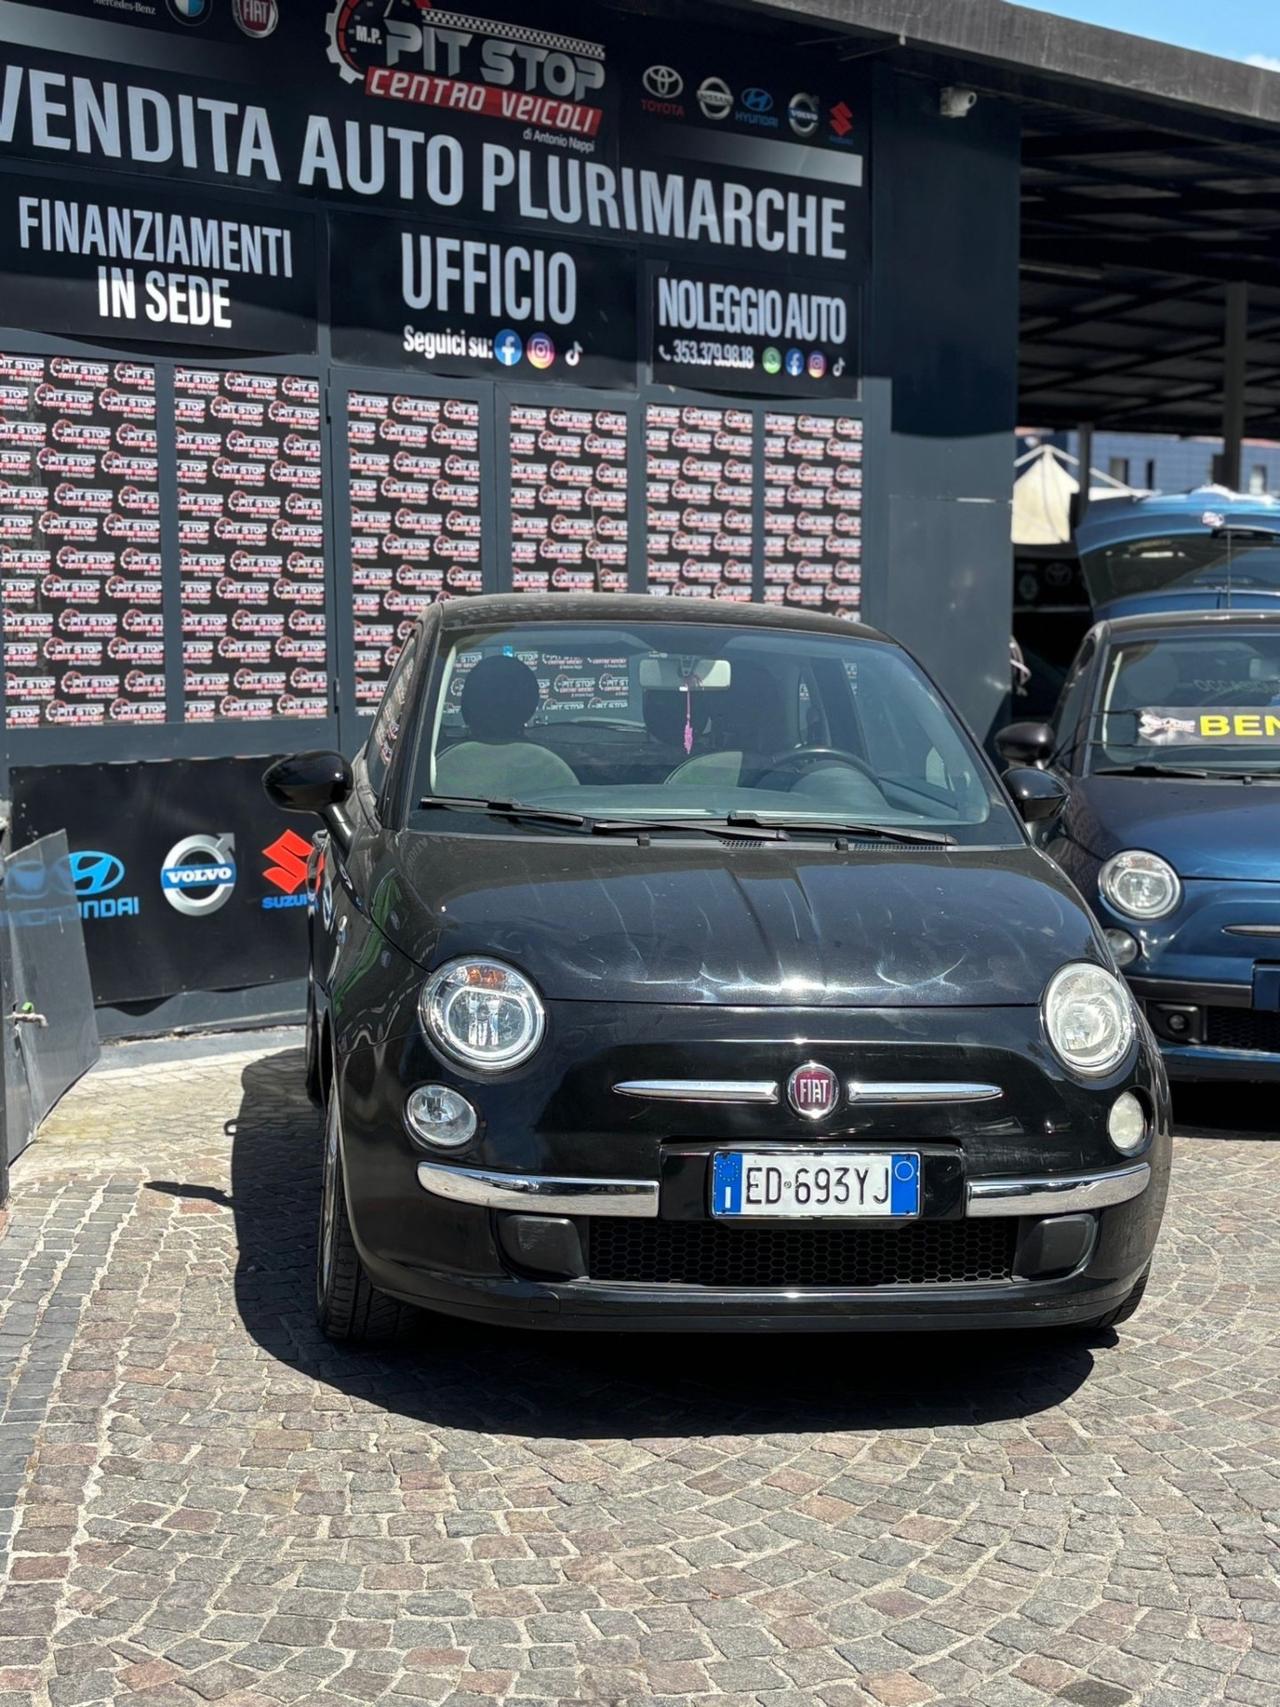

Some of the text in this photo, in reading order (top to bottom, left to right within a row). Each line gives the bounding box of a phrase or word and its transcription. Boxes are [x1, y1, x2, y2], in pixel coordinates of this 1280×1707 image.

[243, 1, 268, 23] FIAT
[356, 25, 382, 44] M.P.
[384, 18, 605, 101] PIT STOP
[641, 99, 684, 118] TOYOTA
[735, 111, 778, 128] HYUNDAI
[790, 110, 818, 121] VOLVO
[523, 128, 595, 154] di Antonio Nappi
[0, 64, 847, 260] VENDITA AUTO PLURIMARCHE
[19, 196, 293, 278] FINANZIAMENTI
[401, 232, 577, 326] UFFICIO
[97, 265, 233, 328] IN SEDE
[658, 277, 847, 344] NOLEGGIO AUTO
[403, 324, 493, 359] Seguici su:
[672, 339, 755, 370] 353.379.98.18
[16, 360, 44, 370] STOP
[62, 364, 109, 375] PIT STOP
[125, 370, 140, 378] PIT
[193, 374, 219, 384] STOP
[252, 379, 277, 388] STOP
[0, 388, 28, 398] STOP
[46, 392, 94, 402] PIT STOP
[111, 396, 156, 407] PIT STOP
[179, 401, 205, 411] STOP
[238, 406, 264, 415] STOP
[295, 409, 319, 419] STOP
[18, 425, 47, 434] STOP
[64, 427, 110, 438] PIT STOP
[127, 432, 143, 441] PIT
[195, 435, 221, 444] STOP
[253, 439, 279, 448] STOP
[3, 453, 31, 463] STOP
[48, 455, 96, 466] PIT STOP
[113, 459, 158, 469] PIT STOP
[181, 463, 207, 472] STOP
[240, 465, 265, 474] STOP
[297, 468, 321, 477] STOP
[0, 488, 49, 498] PIT STOP
[66, 490, 113, 500] PIT STOP
[130, 495, 146, 503] PIT
[197, 496, 223, 505] STOP
[255, 499, 281, 508] STOP
[5, 517, 33, 527] STOP
[50, 518, 98, 528] PIT STOP
[115, 521, 160, 530] PIT STOP
[183, 523, 209, 533] STOP
[242, 525, 267, 534] STOP
[298, 527, 323, 536] STOP
[3, 552, 51, 562] PIT STOP
[68, 554, 115, 563] PIT STOP
[132, 556, 148, 565] PIT
[7, 581, 36, 591] STOP
[52, 581, 100, 591] PIT STOP
[117, 583, 162, 592] PIT STOP
[6, 616, 53, 626] PIT STOP
[70, 616, 117, 626] PIT STOP
[134, 618, 151, 626] PIT
[9, 645, 38, 654] STOP
[55, 644, 102, 654] PIT STOP
[120, 644, 164, 653] PIT STOP
[7, 679, 55, 689] PIT STOP
[72, 678, 119, 688] PIT STOP
[136, 678, 154, 687] PIT
[166, 867, 232, 883] VOLVO
[262, 893, 319, 909] SUZU
[800, 1079, 828, 1103] FIAT
[745, 1167, 889, 1205] ED 693YJ
[725, 1187, 732, 1208] I
